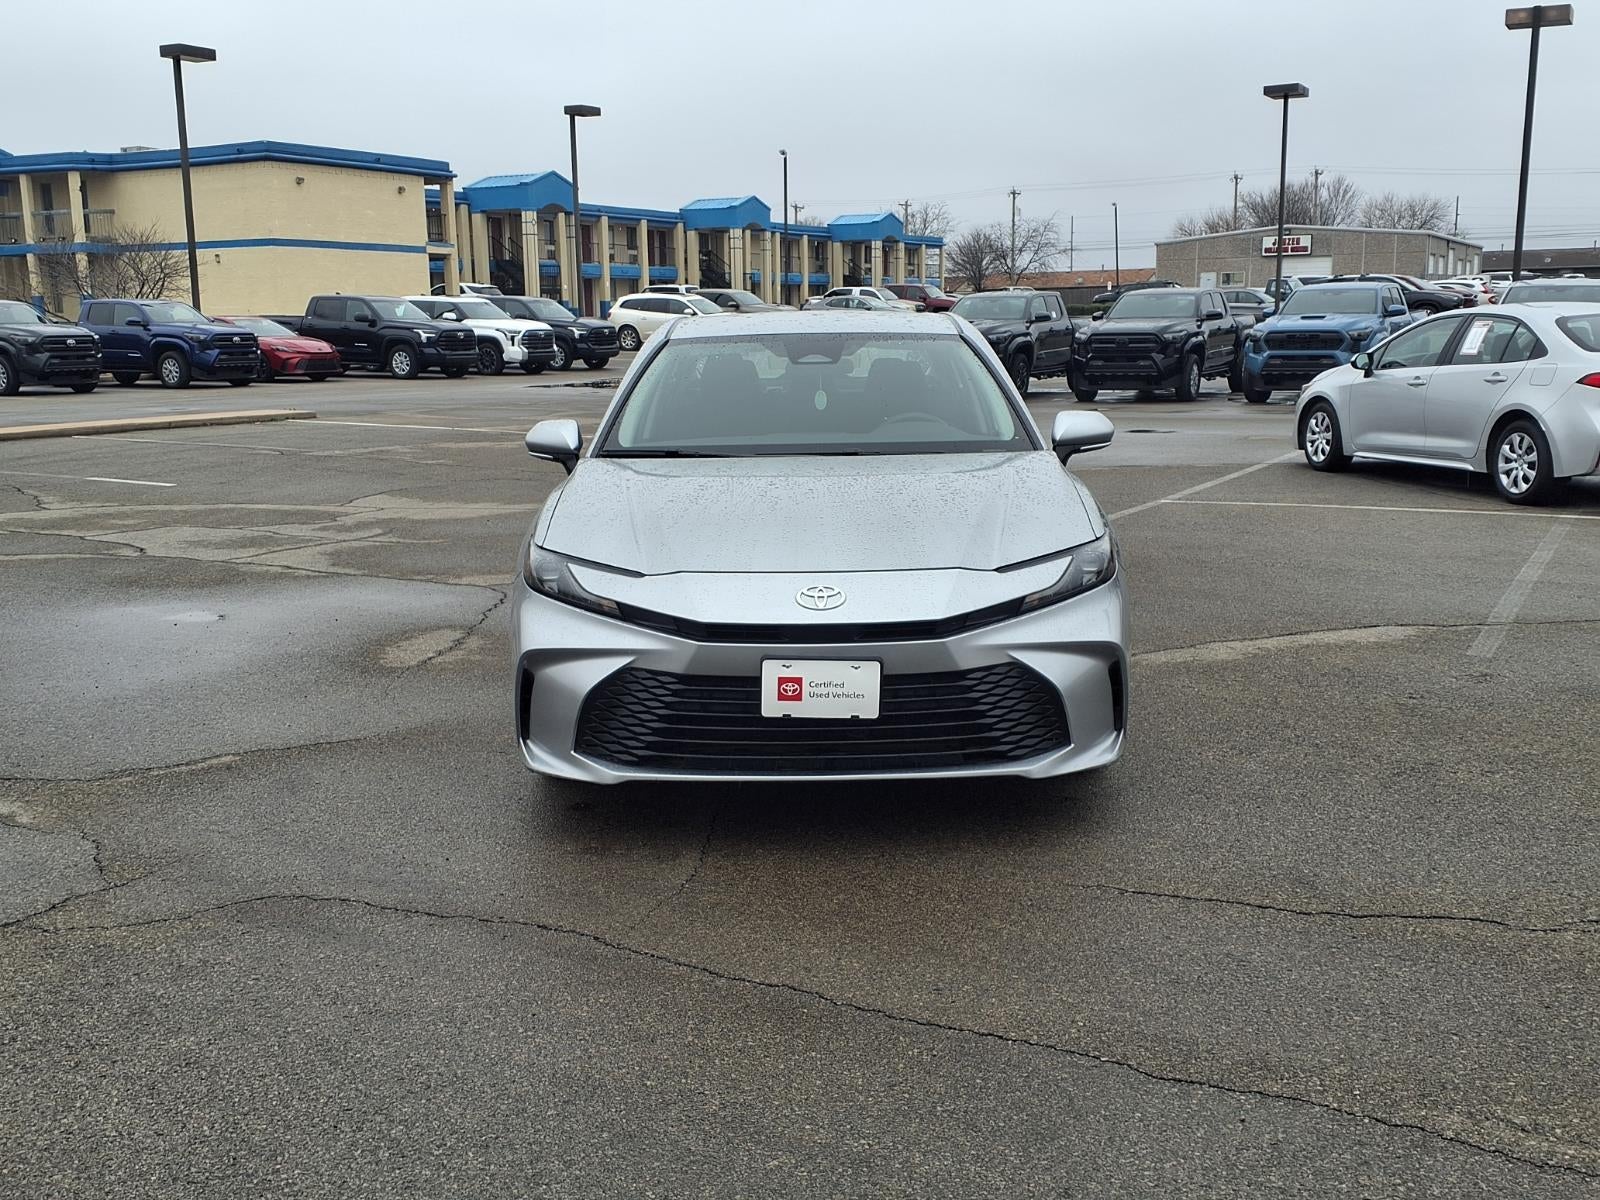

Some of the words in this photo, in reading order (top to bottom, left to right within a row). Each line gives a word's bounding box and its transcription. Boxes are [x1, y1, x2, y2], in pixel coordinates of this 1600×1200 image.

[808, 680, 845, 689] Certified
[808, 691, 830, 699] Used
[831, 691, 865, 699] Vehicles
